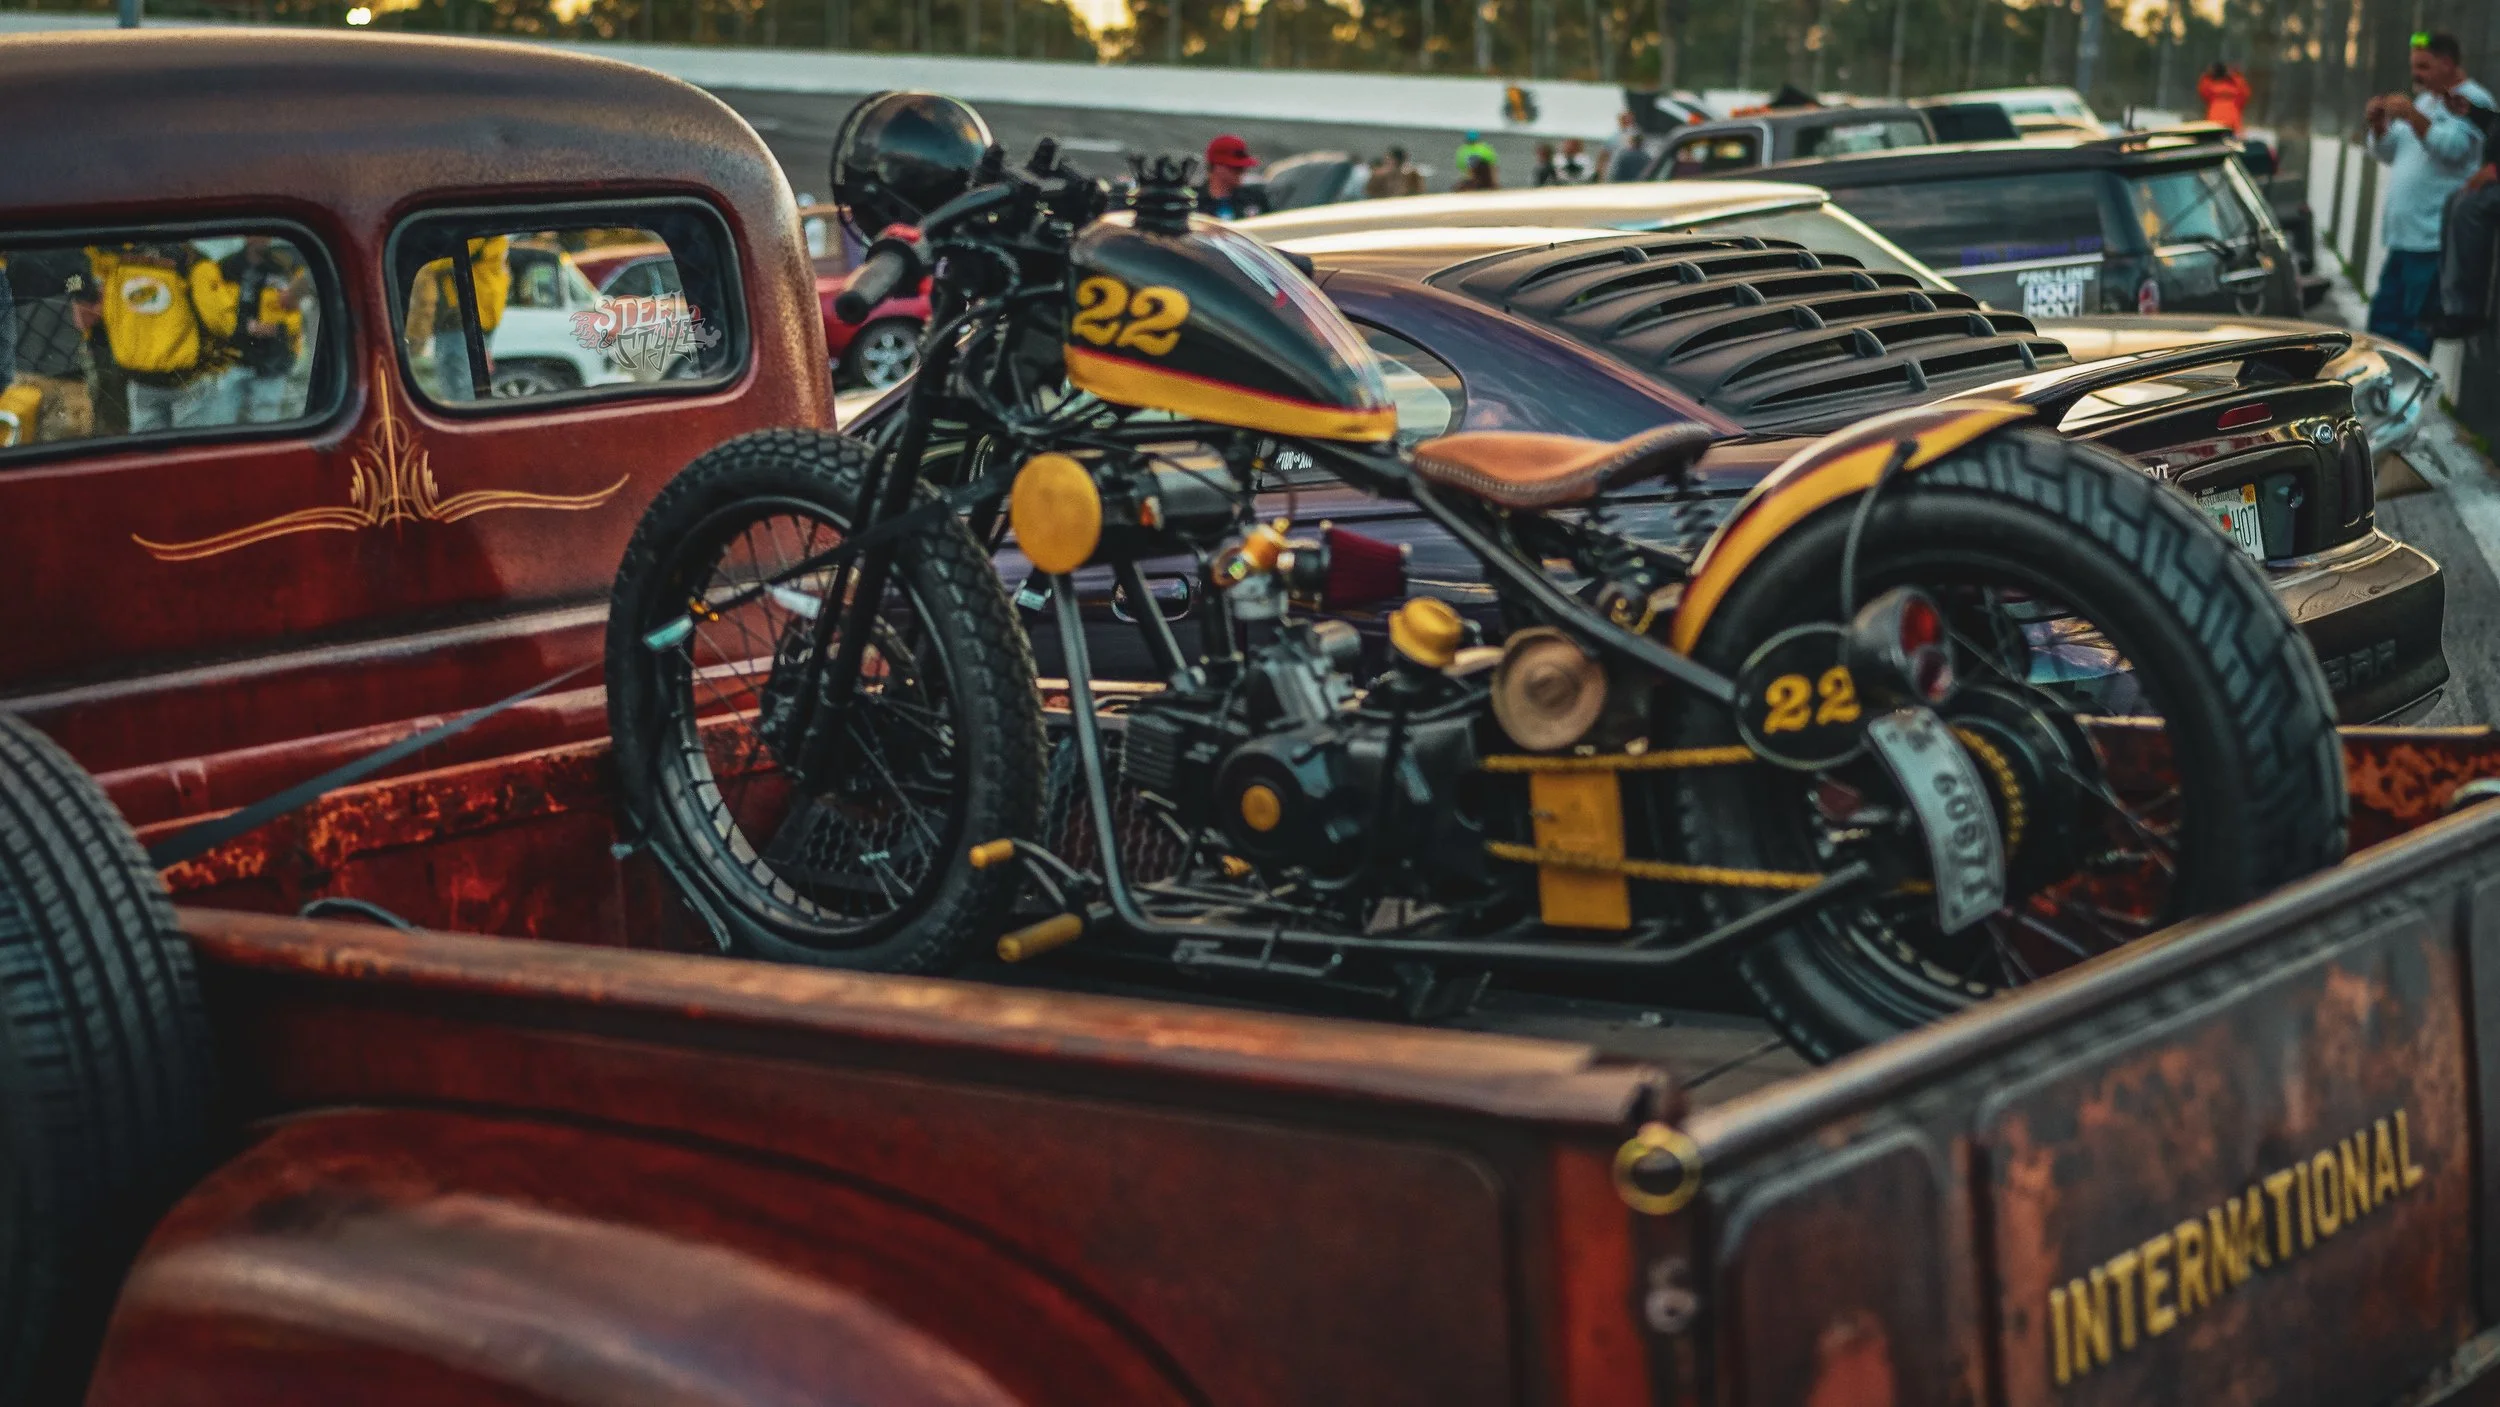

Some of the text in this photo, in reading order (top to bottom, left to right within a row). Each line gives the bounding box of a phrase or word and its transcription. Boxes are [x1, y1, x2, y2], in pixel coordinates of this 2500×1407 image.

[593, 289, 692, 334] STEEL
[600, 317, 706, 373] & STYLE
[1072, 275, 1190, 356] 22
[1763, 665, 1863, 734] 22
[2049, 1108, 2424, 1385] INTERNATIONAL
